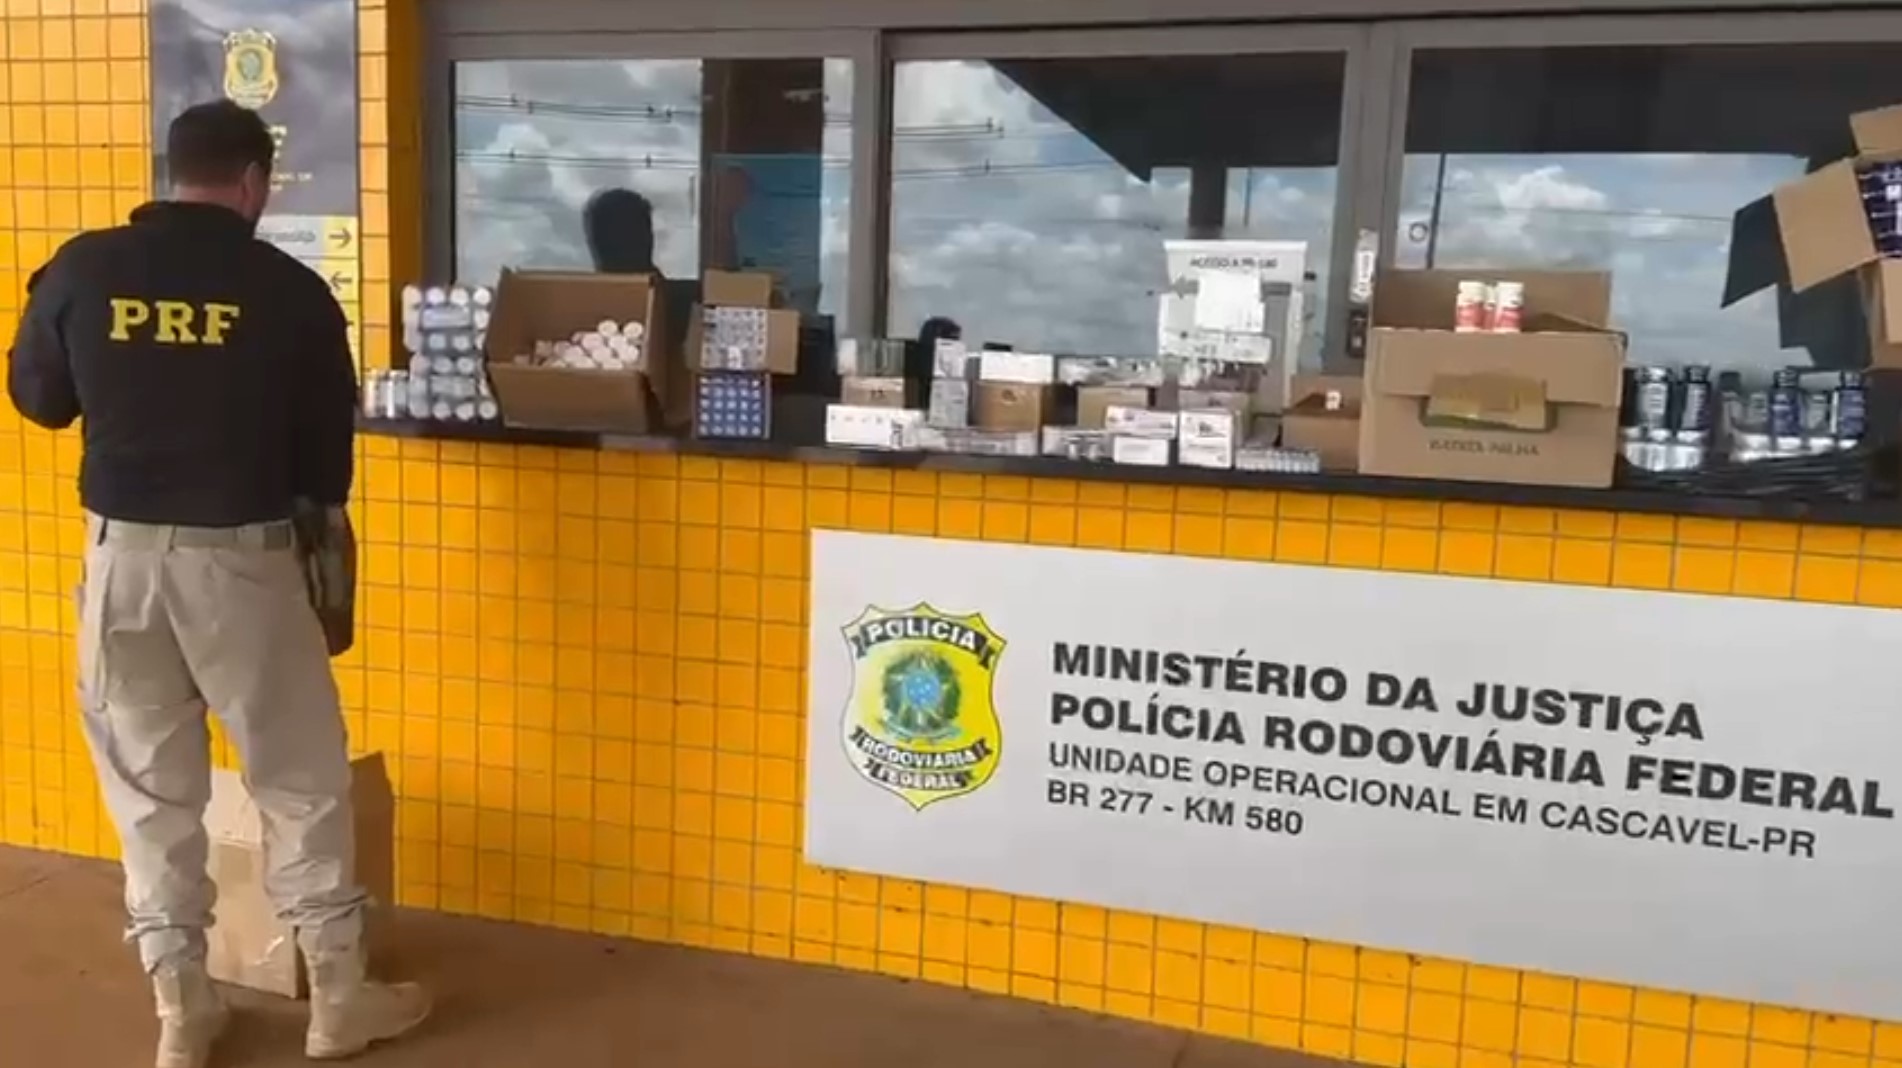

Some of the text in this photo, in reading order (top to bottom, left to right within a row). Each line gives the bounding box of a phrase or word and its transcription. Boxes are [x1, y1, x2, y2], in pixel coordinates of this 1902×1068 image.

[109, 298, 240, 344] PRF
[1053, 642, 1704, 746] MINISTÉRIO DA JUSTIÇA
[876, 766, 961, 789] FEDERAL
[1051, 692, 1894, 819] POLÍCIA RODOVIÁRIA FEDERAL
[1048, 779, 1089, 807] BR
[1100, 787, 1153, 814] 277
[1184, 796, 1234, 826] KM
[1245, 808, 1303, 836] 580
[1050, 742, 1816, 859] UNIDADE OPERACIONAL EM CASCAVEL-PR
